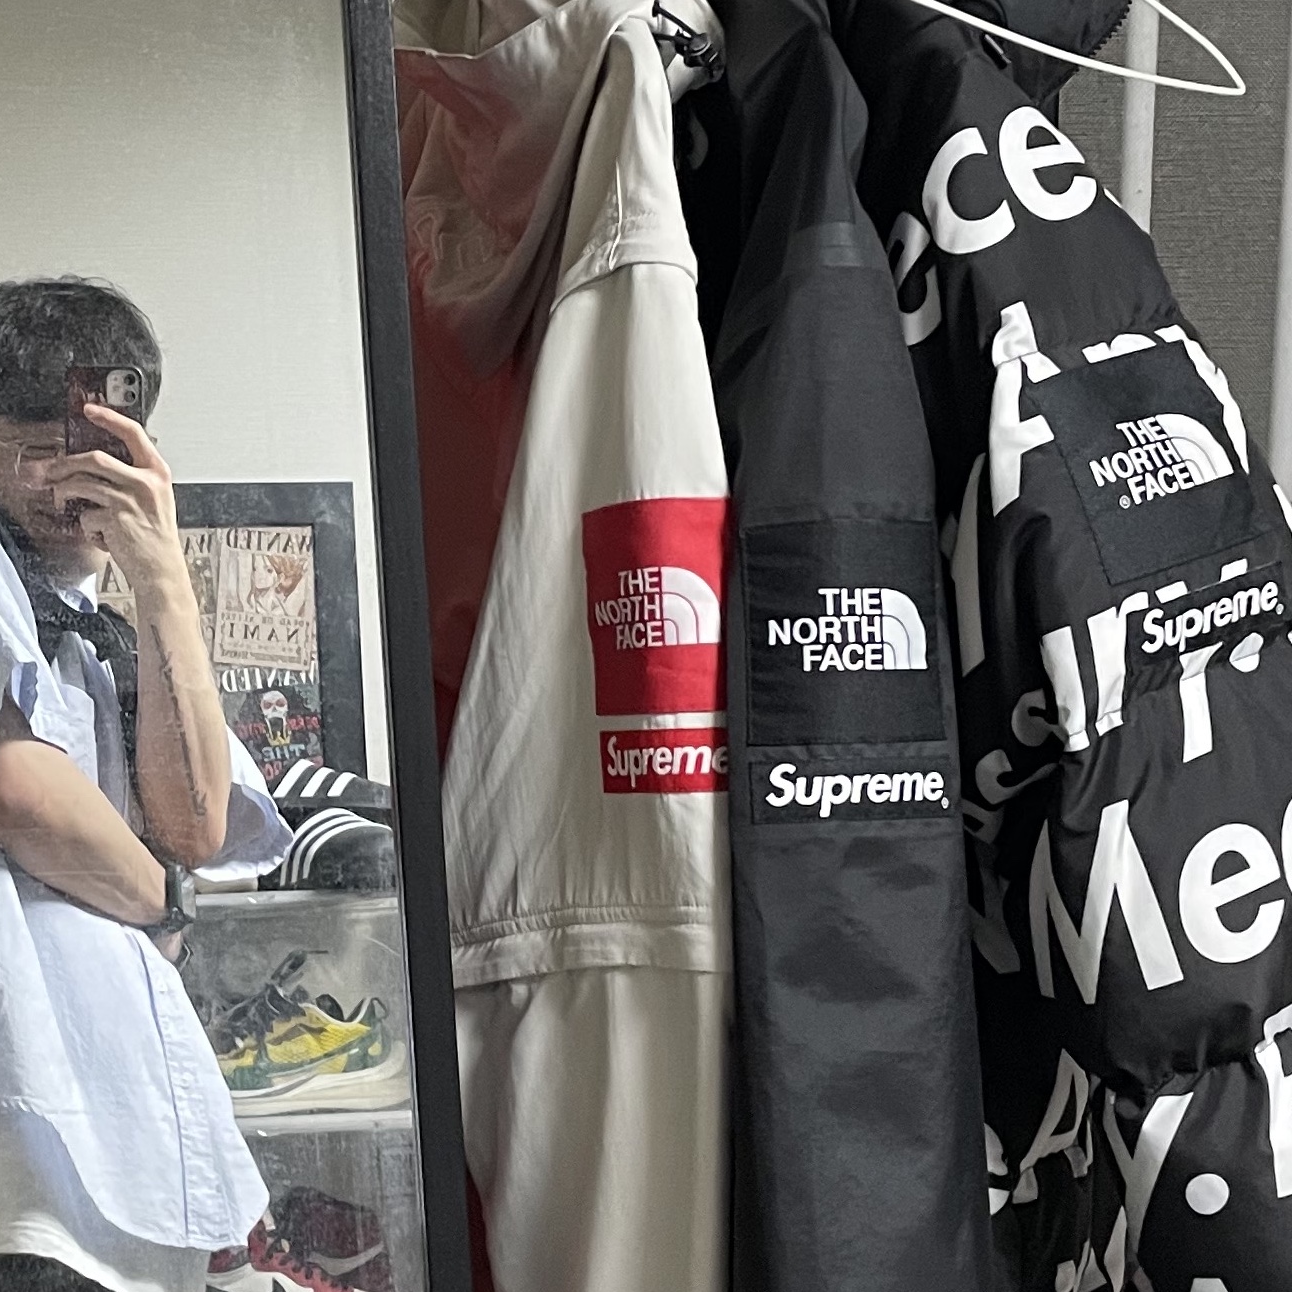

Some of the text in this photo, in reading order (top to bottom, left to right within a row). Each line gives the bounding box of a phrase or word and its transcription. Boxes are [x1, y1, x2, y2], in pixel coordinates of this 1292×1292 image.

[1116, 416, 1169, 447] THE
[1089, 439, 1182, 487] NORTH
[1126, 463, 1195, 505] FACE
[618, 566, 661, 596] THE
[594, 594, 663, 627] NORTH
[818, 588, 882, 616] THE
[1141, 582, 1279, 653] Supreme
[615, 621, 665, 650] FACE
[768, 615, 882, 646] NORTH
[803, 643, 884, 672] FACE
[607, 736, 729, 788] Supreme
[765, 763, 945, 818] Supreme
[1029, 799, 1292, 1005] Me
